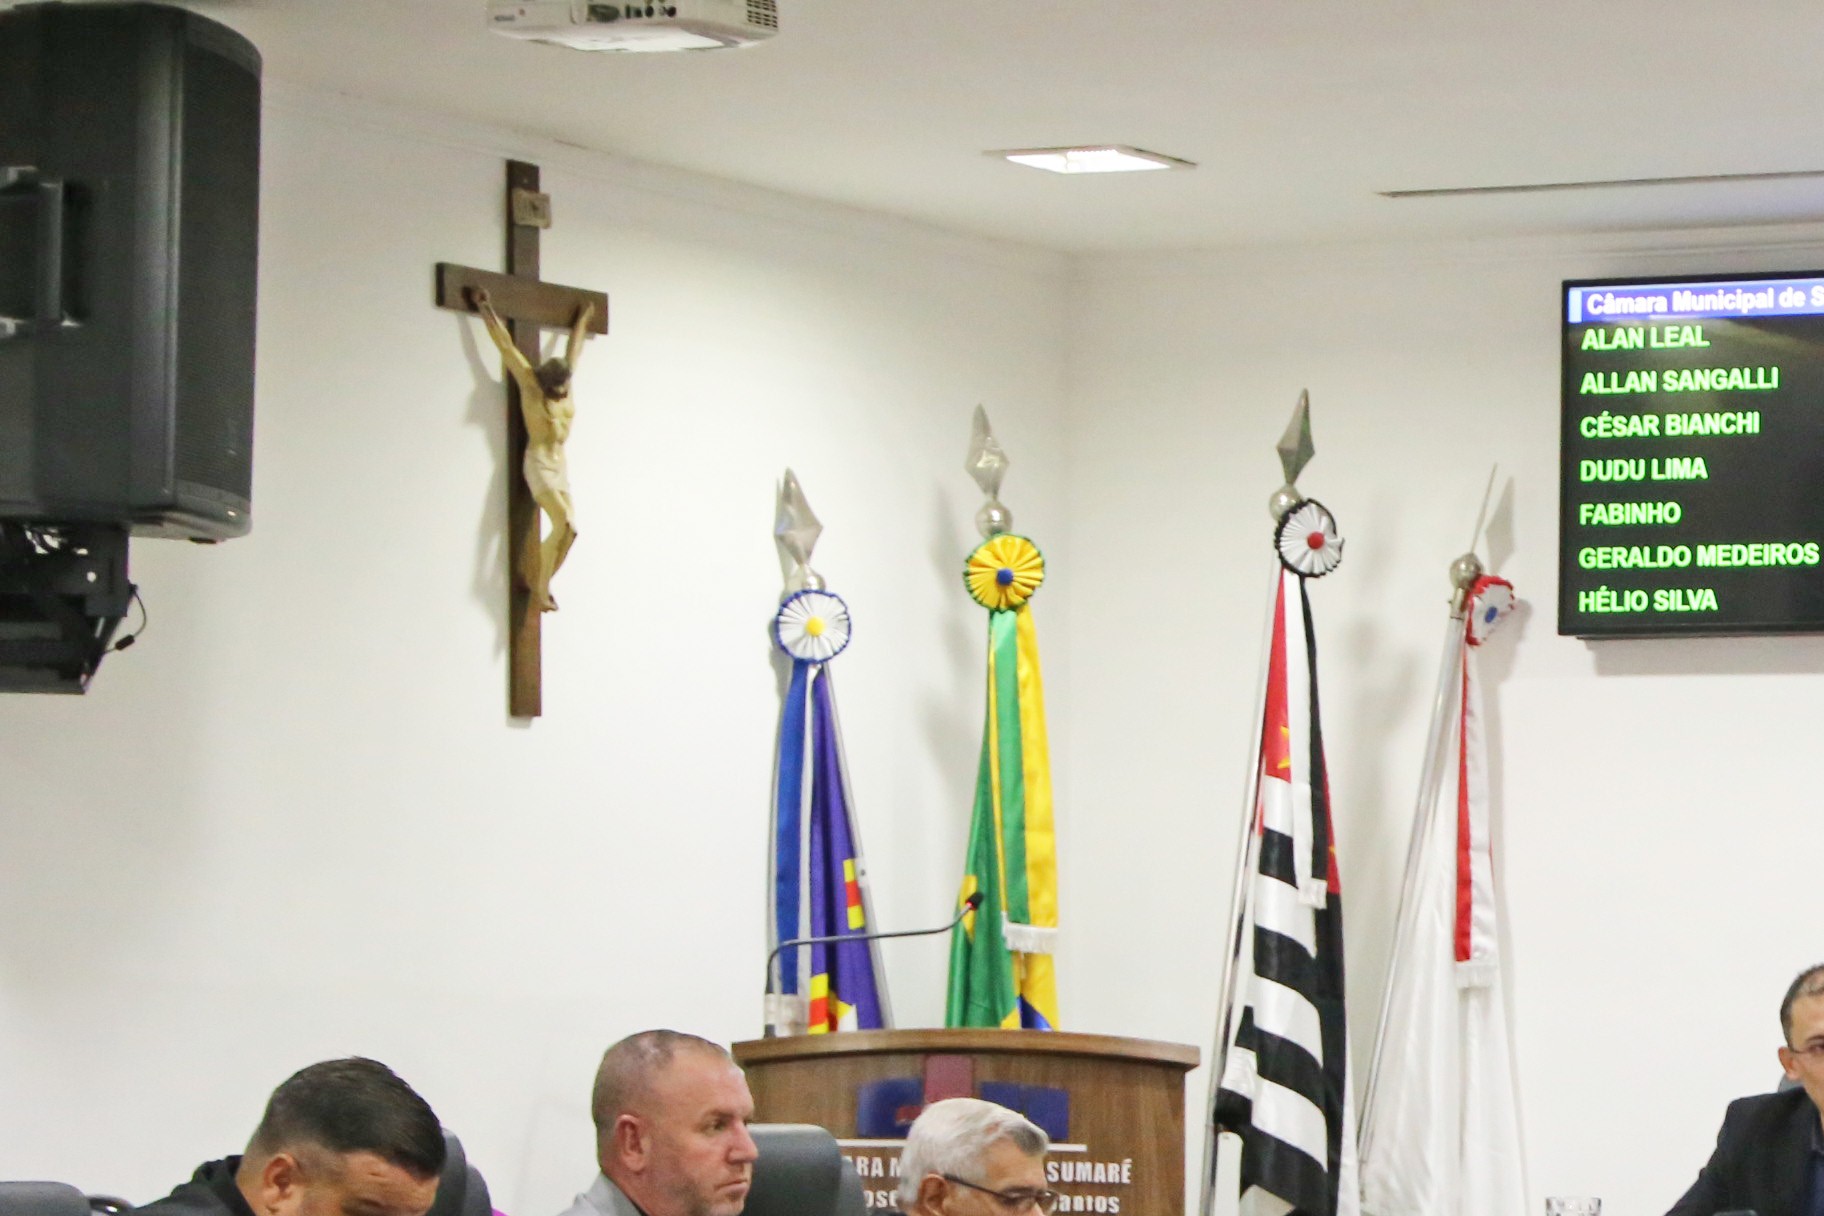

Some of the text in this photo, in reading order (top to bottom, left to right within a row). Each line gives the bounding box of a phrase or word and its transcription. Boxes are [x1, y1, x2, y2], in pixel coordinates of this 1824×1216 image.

[1587, 292, 1667, 314] Câmara
[1673, 286, 1772, 310] Municipal
[1780, 287, 1806, 308] de
[1582, 327, 1709, 350] ALAN LEAL
[1580, 367, 1778, 394] ALLAN SANGALLI
[1580, 411, 1759, 438] CÉSAR BIANCHI
[1580, 457, 1708, 482] DUDU LIMA
[1580, 502, 1681, 525] FABINHO
[1579, 543, 1819, 569] GERALDO MEDEIROS
[1579, 586, 1718, 612] HÉLIO SILVA
[1046, 1158, 1133, 1184] SUMARÉ
